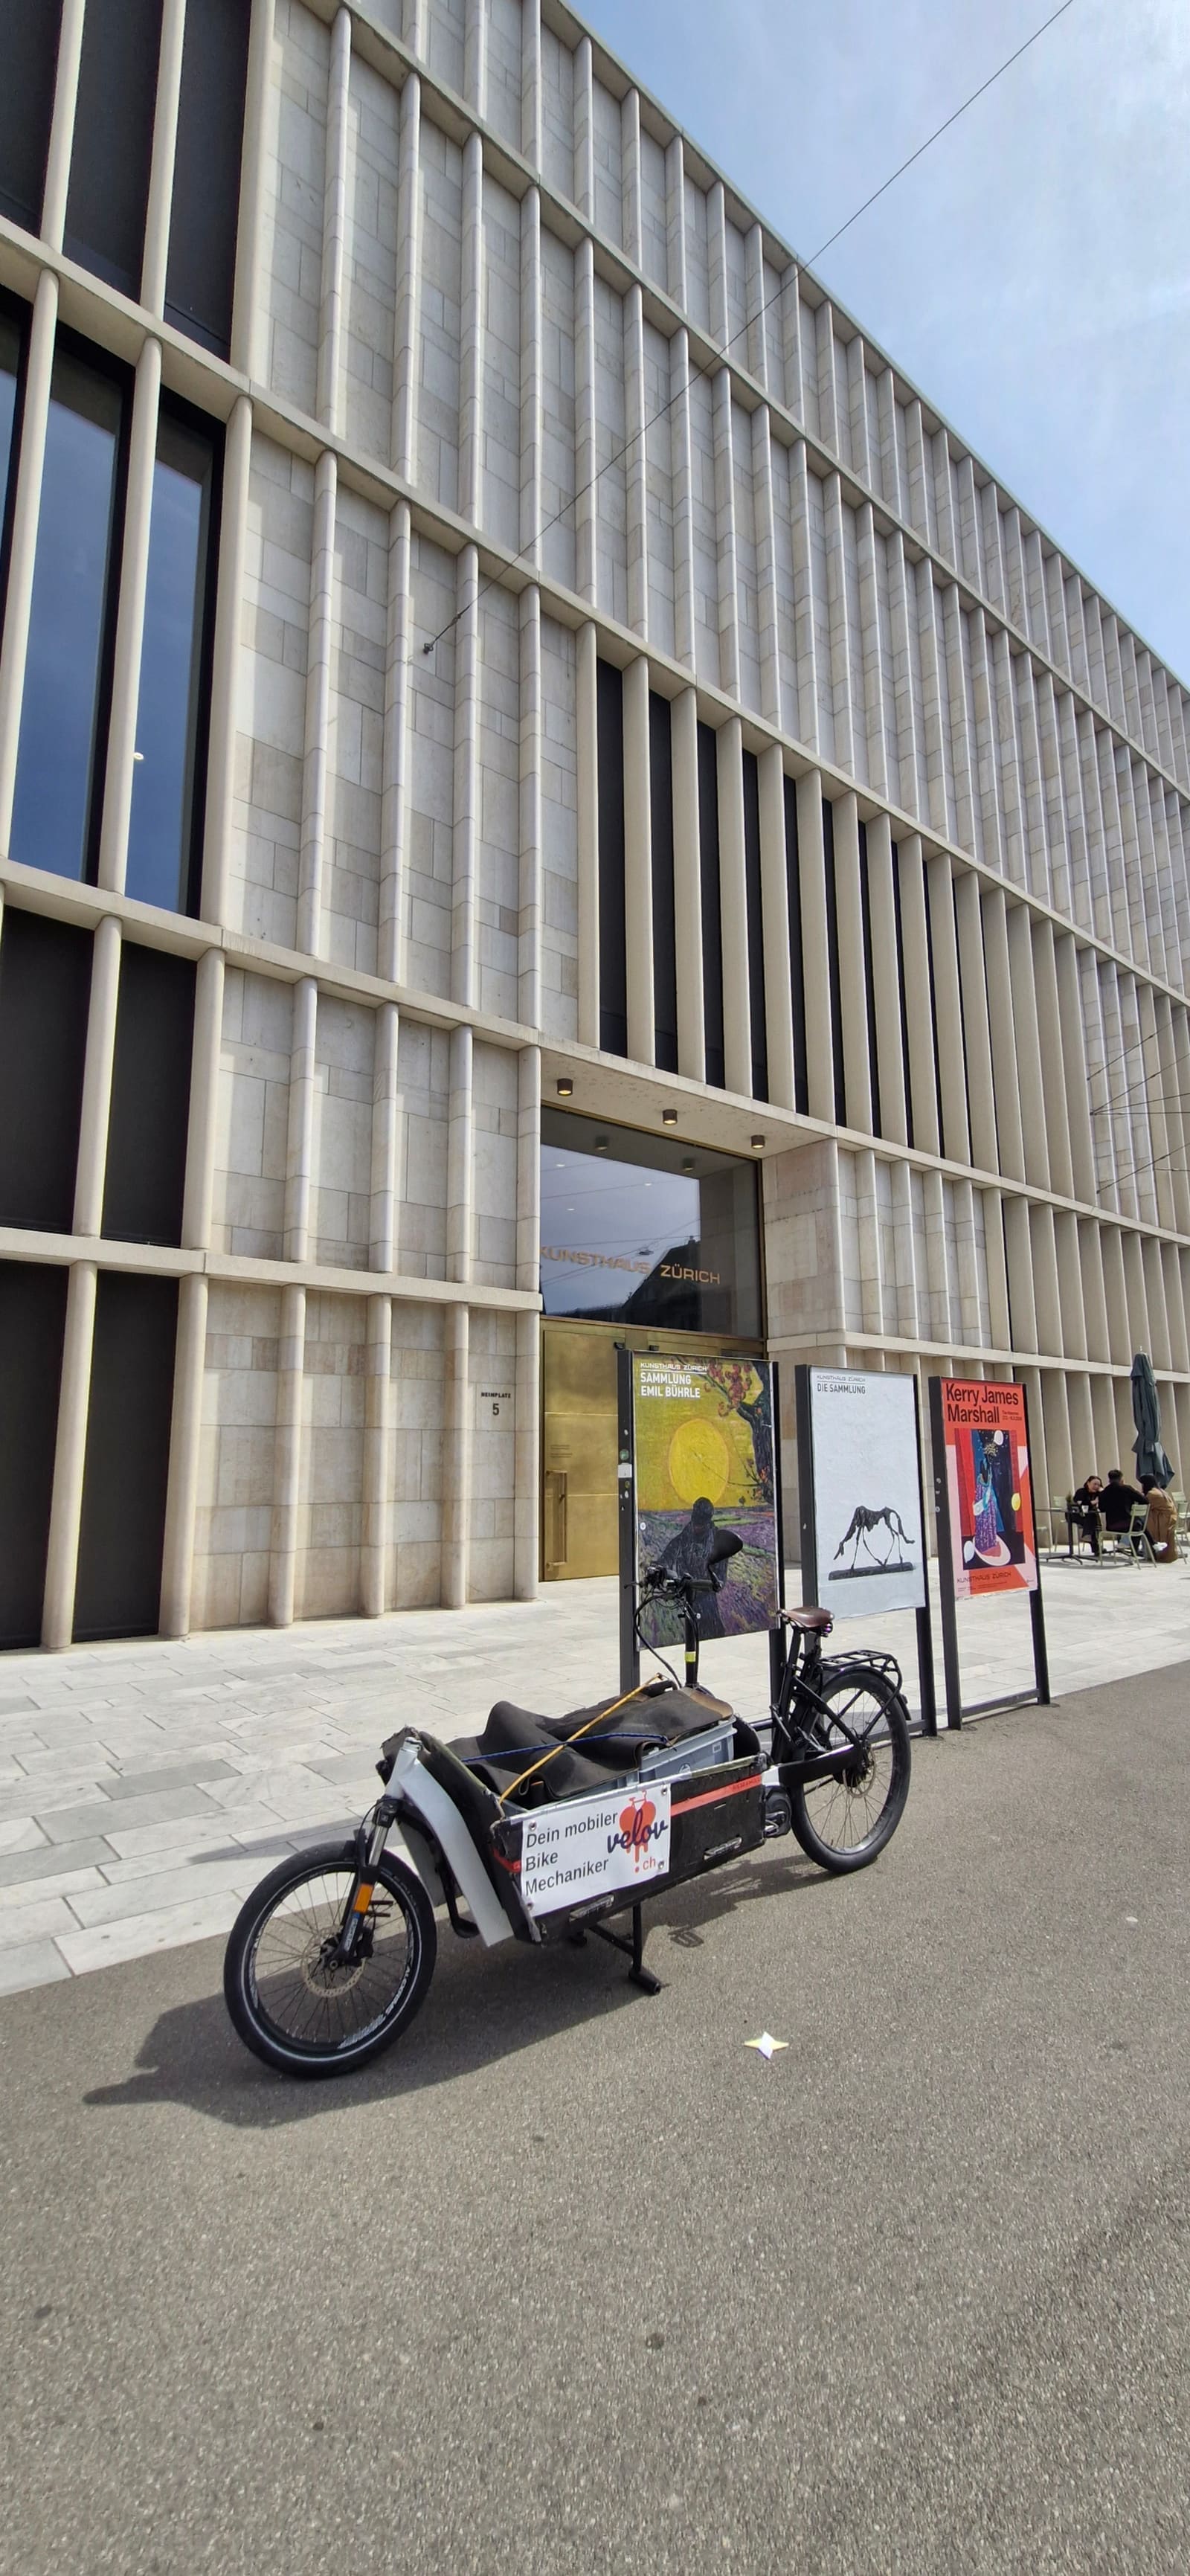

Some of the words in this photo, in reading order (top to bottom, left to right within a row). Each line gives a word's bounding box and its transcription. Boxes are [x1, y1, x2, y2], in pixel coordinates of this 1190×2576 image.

[540, 1246, 652, 1273] KUNSTHAUS
[660, 1264, 720, 1285] ZÜRICH
[640, 1362, 681, 1370] KUNSTHAUS
[684, 1364, 707, 1372] ZÜRICH
[640, 1372, 692, 1385] SAMMLUNG
[640, 1385, 663, 1397] EMIL
[665, 1385, 701, 1398] BÜHRLE
[817, 1383, 829, 1393] DIE
[829, 1385, 866, 1395] SAMMLUNG
[946, 1383, 980, 1407] Kerry
[982, 1386, 1019, 1406] James
[492, 1403, 500, 1416] 5
[948, 1404, 1000, 1424] Marshall
[527, 1828, 559, 1849] Dein
[565, 1811, 618, 1838] mobiler
[607, 1808, 669, 1854] velov
[525, 1852, 559, 1872] Bike
[525, 1857, 609, 1897] Mechaniker
